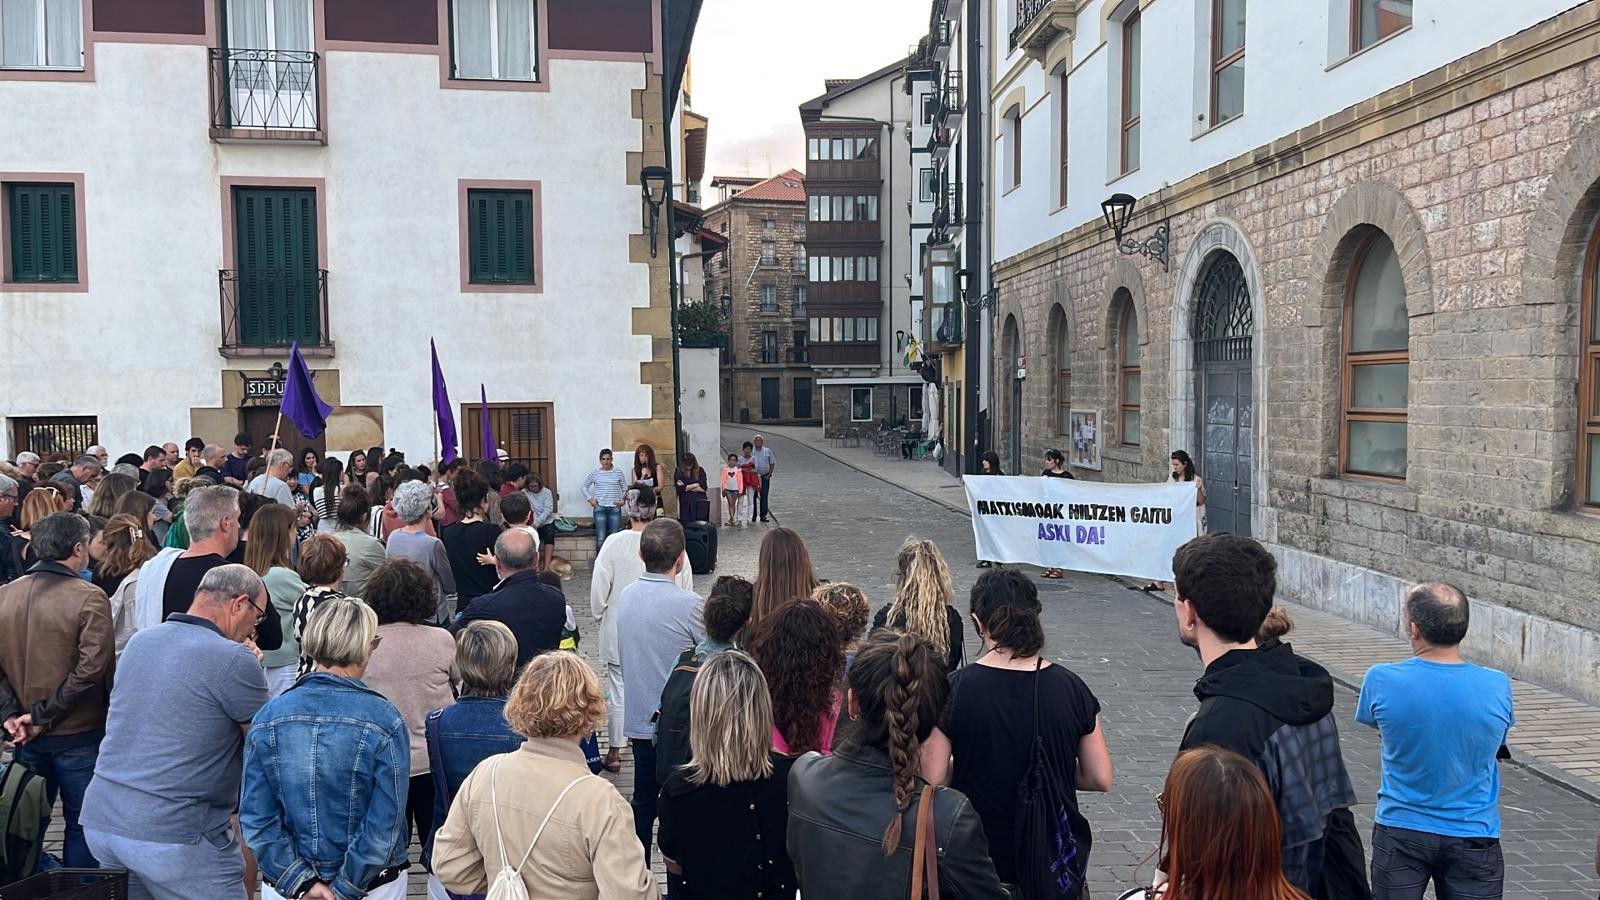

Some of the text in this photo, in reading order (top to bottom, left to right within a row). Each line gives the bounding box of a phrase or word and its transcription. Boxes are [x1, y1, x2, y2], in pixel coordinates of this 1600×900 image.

[977, 500, 1172, 524] MATXISMOAK HILTZEN GAITU
[1038, 522, 1105, 545] ASKI DA!
